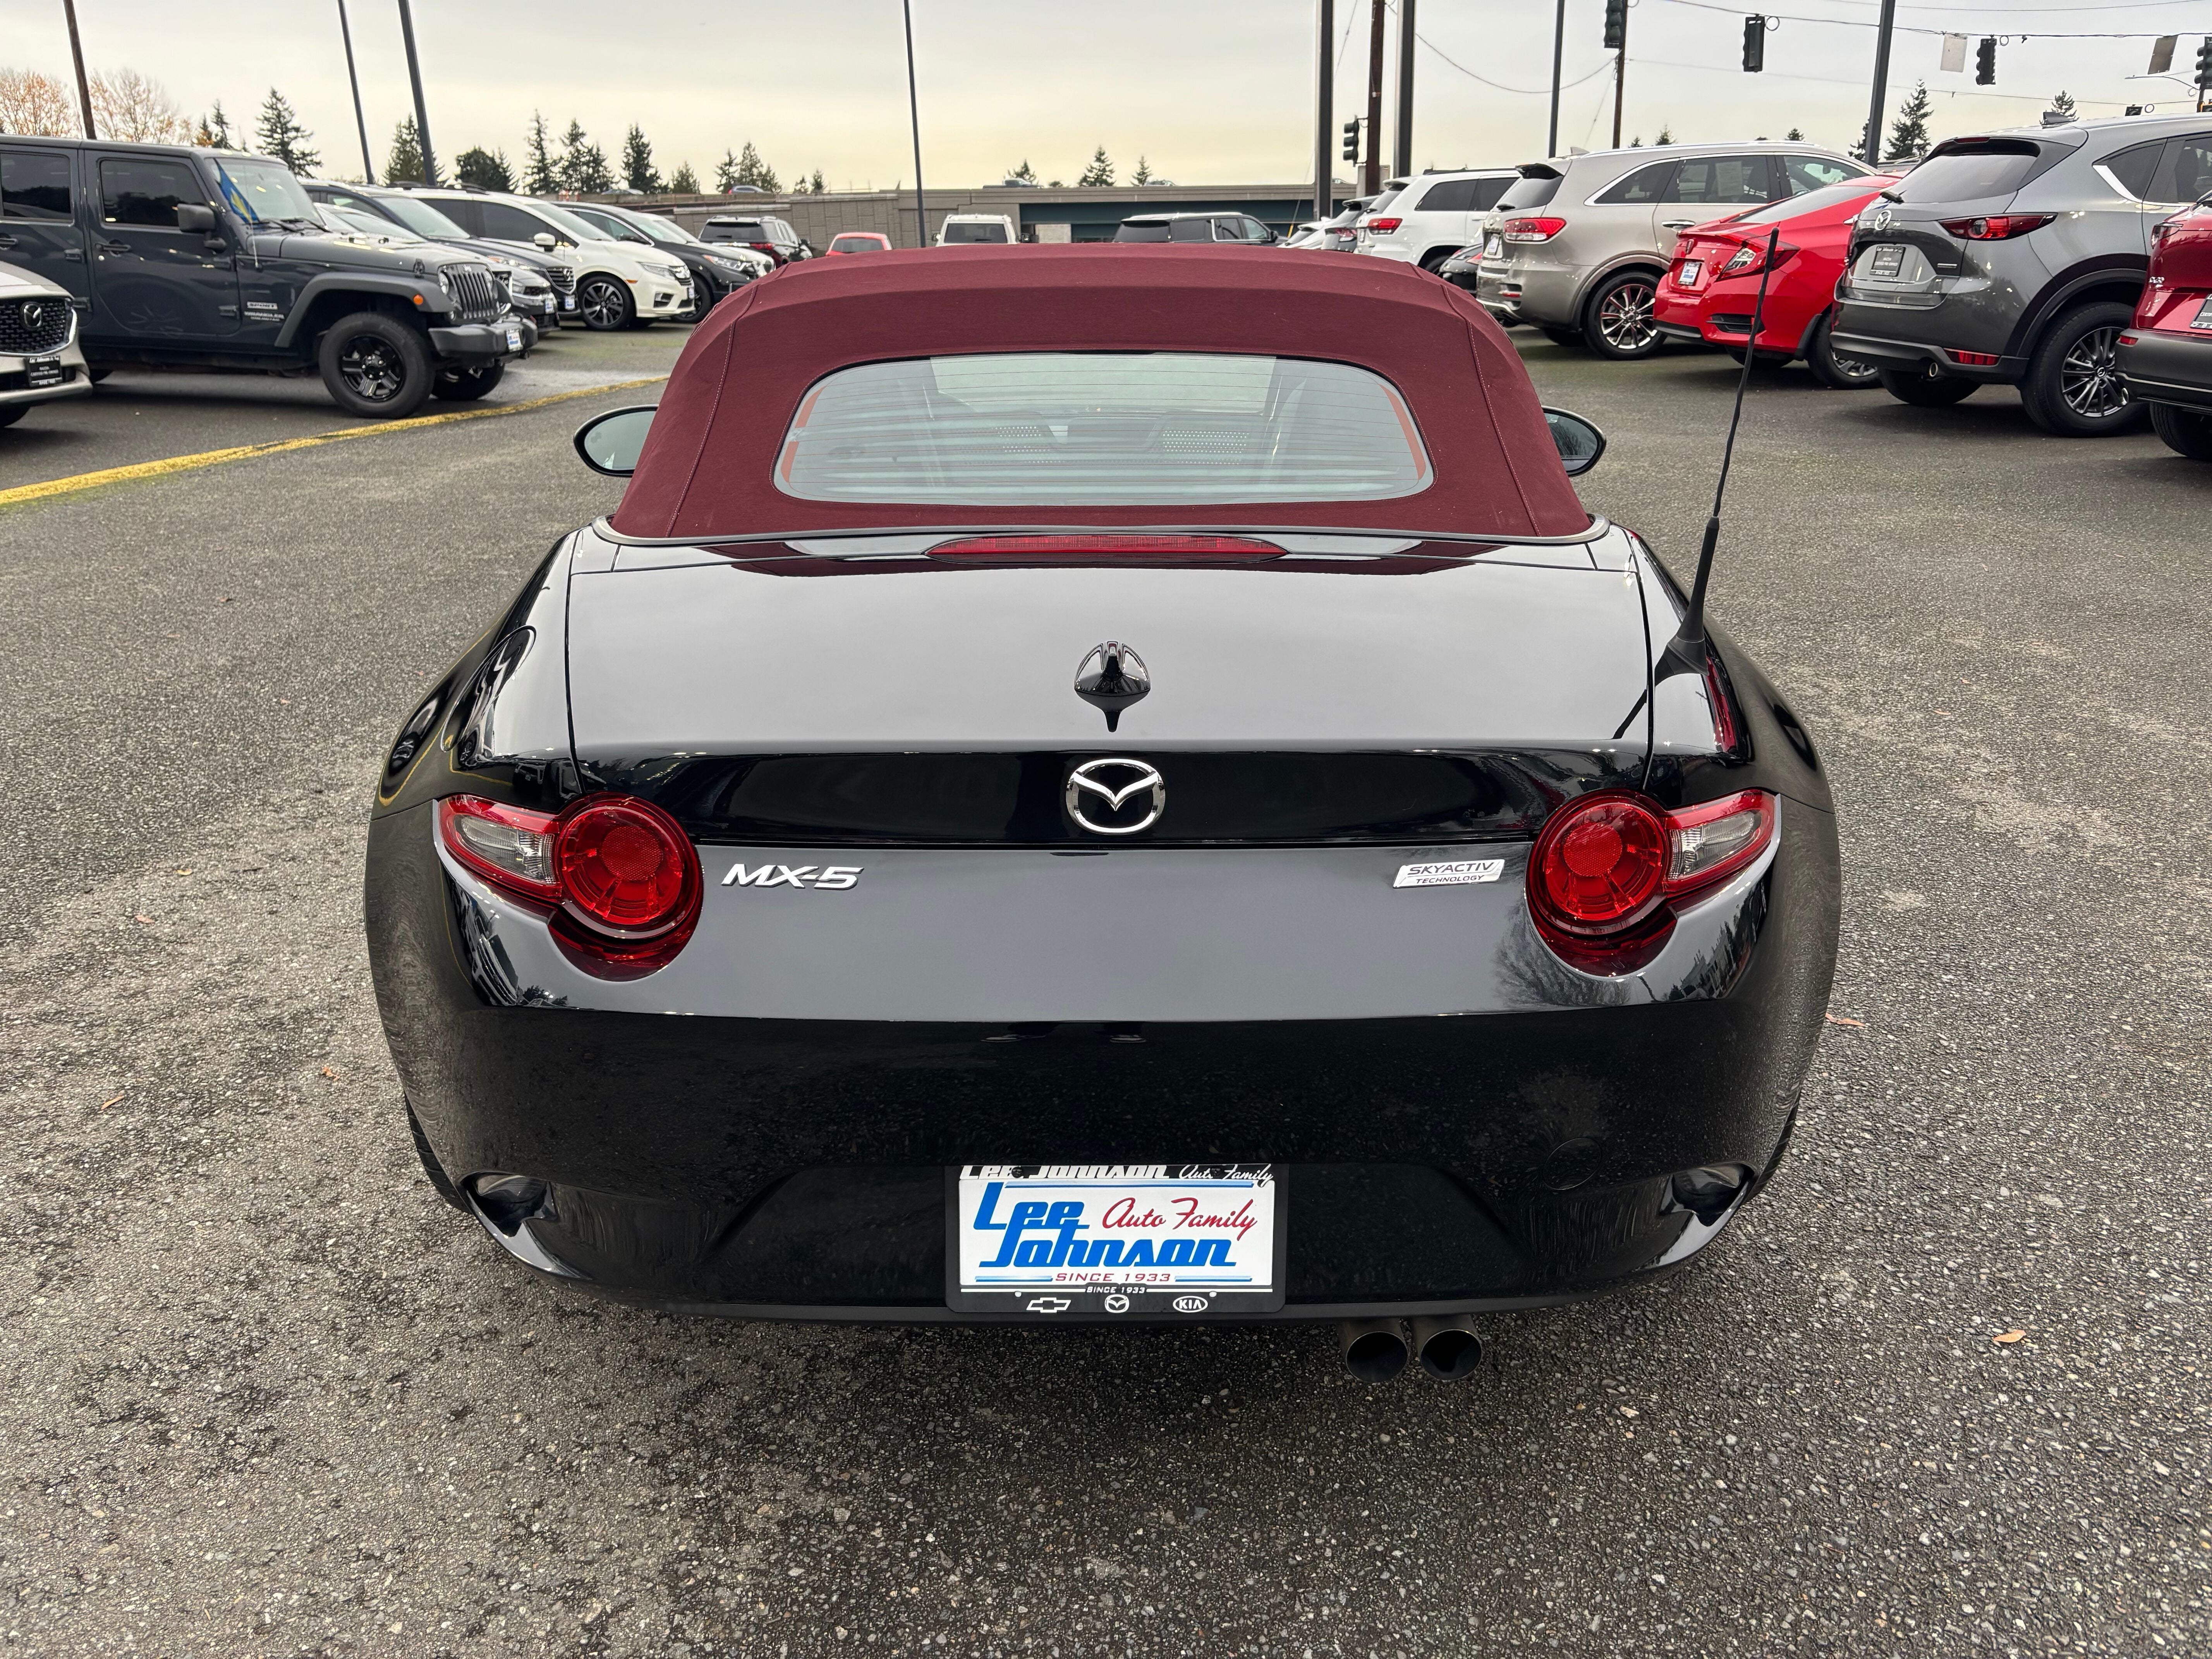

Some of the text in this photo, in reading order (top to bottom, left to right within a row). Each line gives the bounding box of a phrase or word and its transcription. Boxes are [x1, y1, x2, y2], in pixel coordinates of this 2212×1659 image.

[721, 864, 864, 890] MX-5
[1407, 862, 1495, 875] SKYACTIV
[1415, 875, 1485, 884] TECHNOLOGY
[1222, 1164, 1273, 1187] Family
[974, 1182, 1089, 1230] Lee
[1102, 1197, 1258, 1241] Auto Family
[979, 1224, 1236, 1267] Johnson
[1055, 1273, 1171, 1282] SINCE 1933
[1179, 1299, 1202, 1310] KIA
